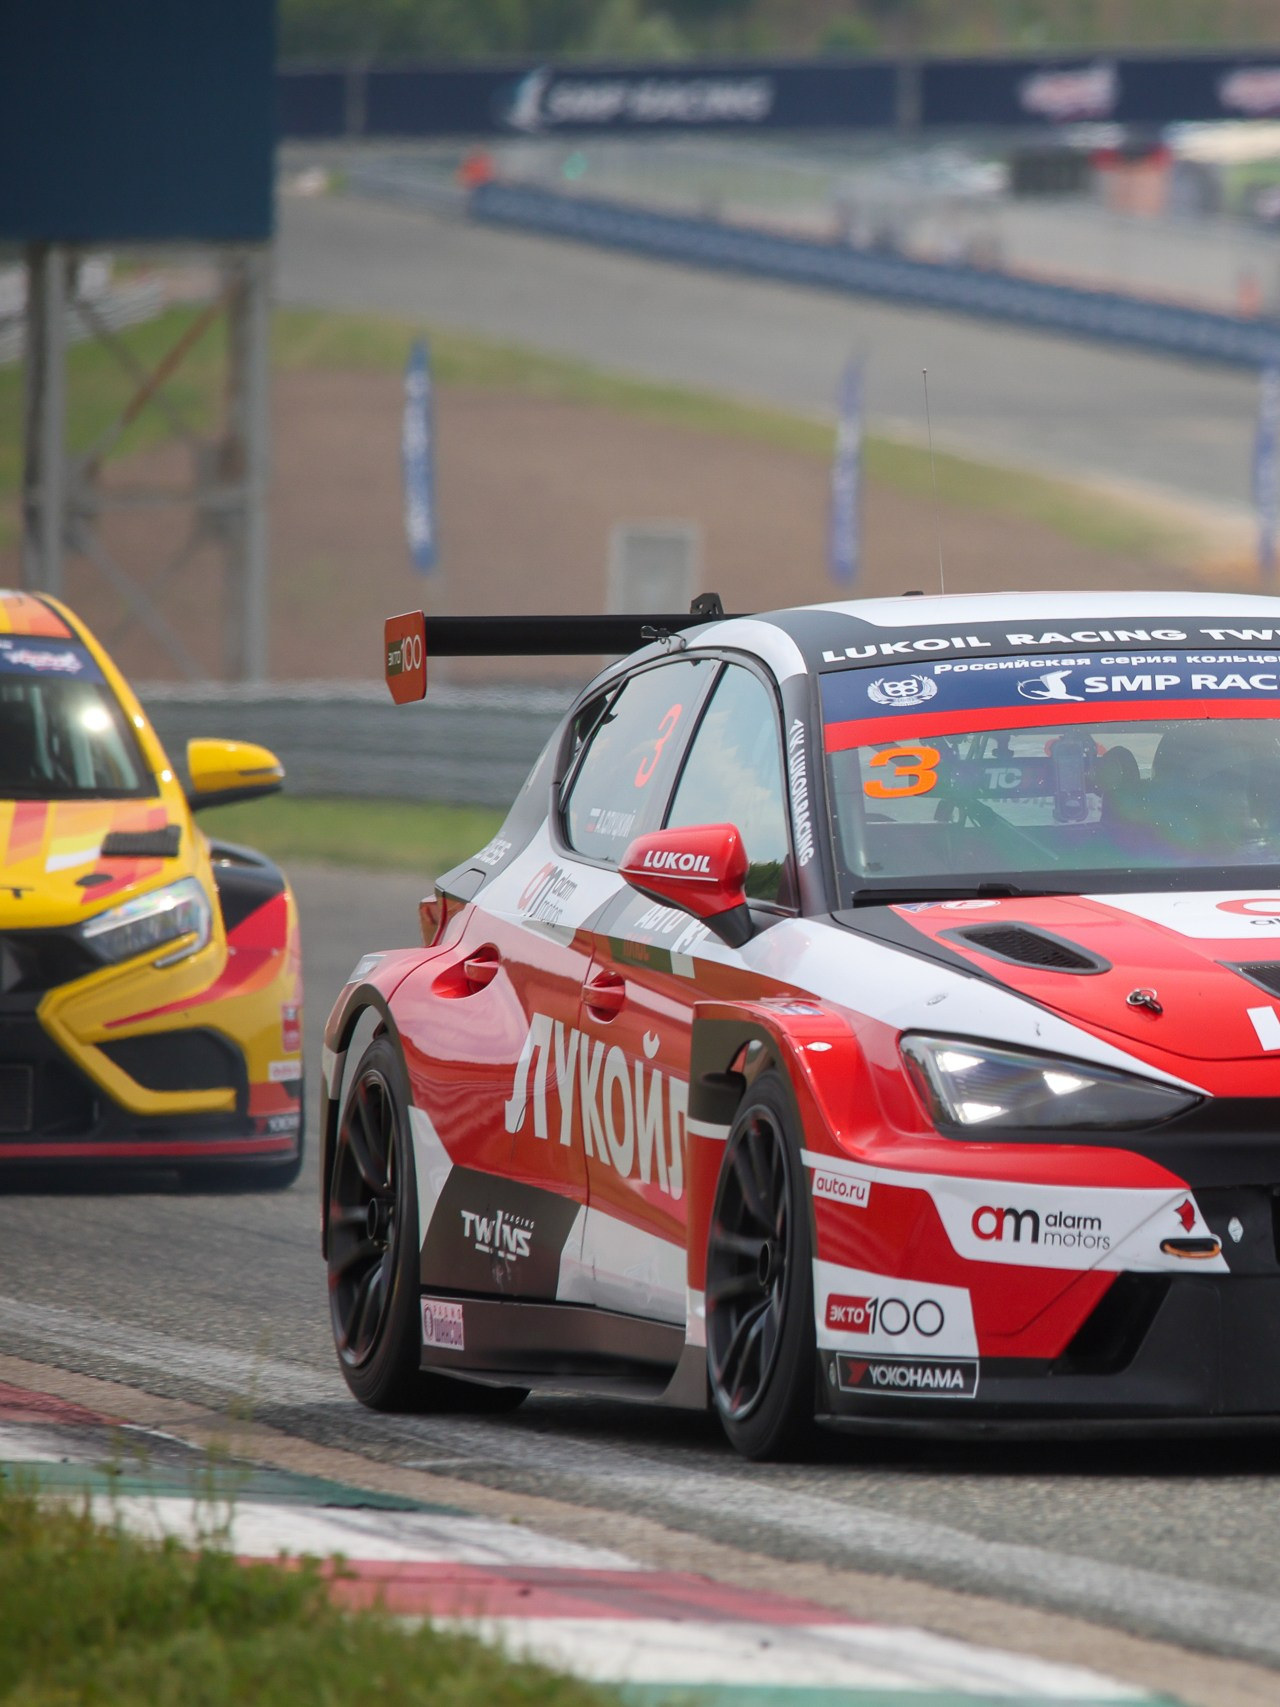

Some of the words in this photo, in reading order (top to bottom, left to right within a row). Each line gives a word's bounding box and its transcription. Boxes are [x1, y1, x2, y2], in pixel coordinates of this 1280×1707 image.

[401, 634, 422, 673] 100
[822, 635, 992, 663] LUKOIL
[1006, 628, 1188, 646] RACING
[934, 656, 1091, 675] Российская
[1101, 655, 1178, 667] серия
[1084, 674, 1182, 694] SMP
[634, 703, 683, 788] 3
[864, 746, 941, 799] 3
[643, 849, 711, 874] LUKOIL
[816, 1174, 866, 1202] auto.ru
[461, 1209, 533, 1258] TWINS
[504, 1212, 536, 1230] RACING
[971, 1204, 1040, 1244] am
[1045, 1211, 1102, 1231] alarm
[1044, 1230, 1111, 1250] motors
[829, 1304, 865, 1325] ЭКТО
[865, 1296, 945, 1337] 100
[869, 1364, 965, 1390] YOKOHAMA
